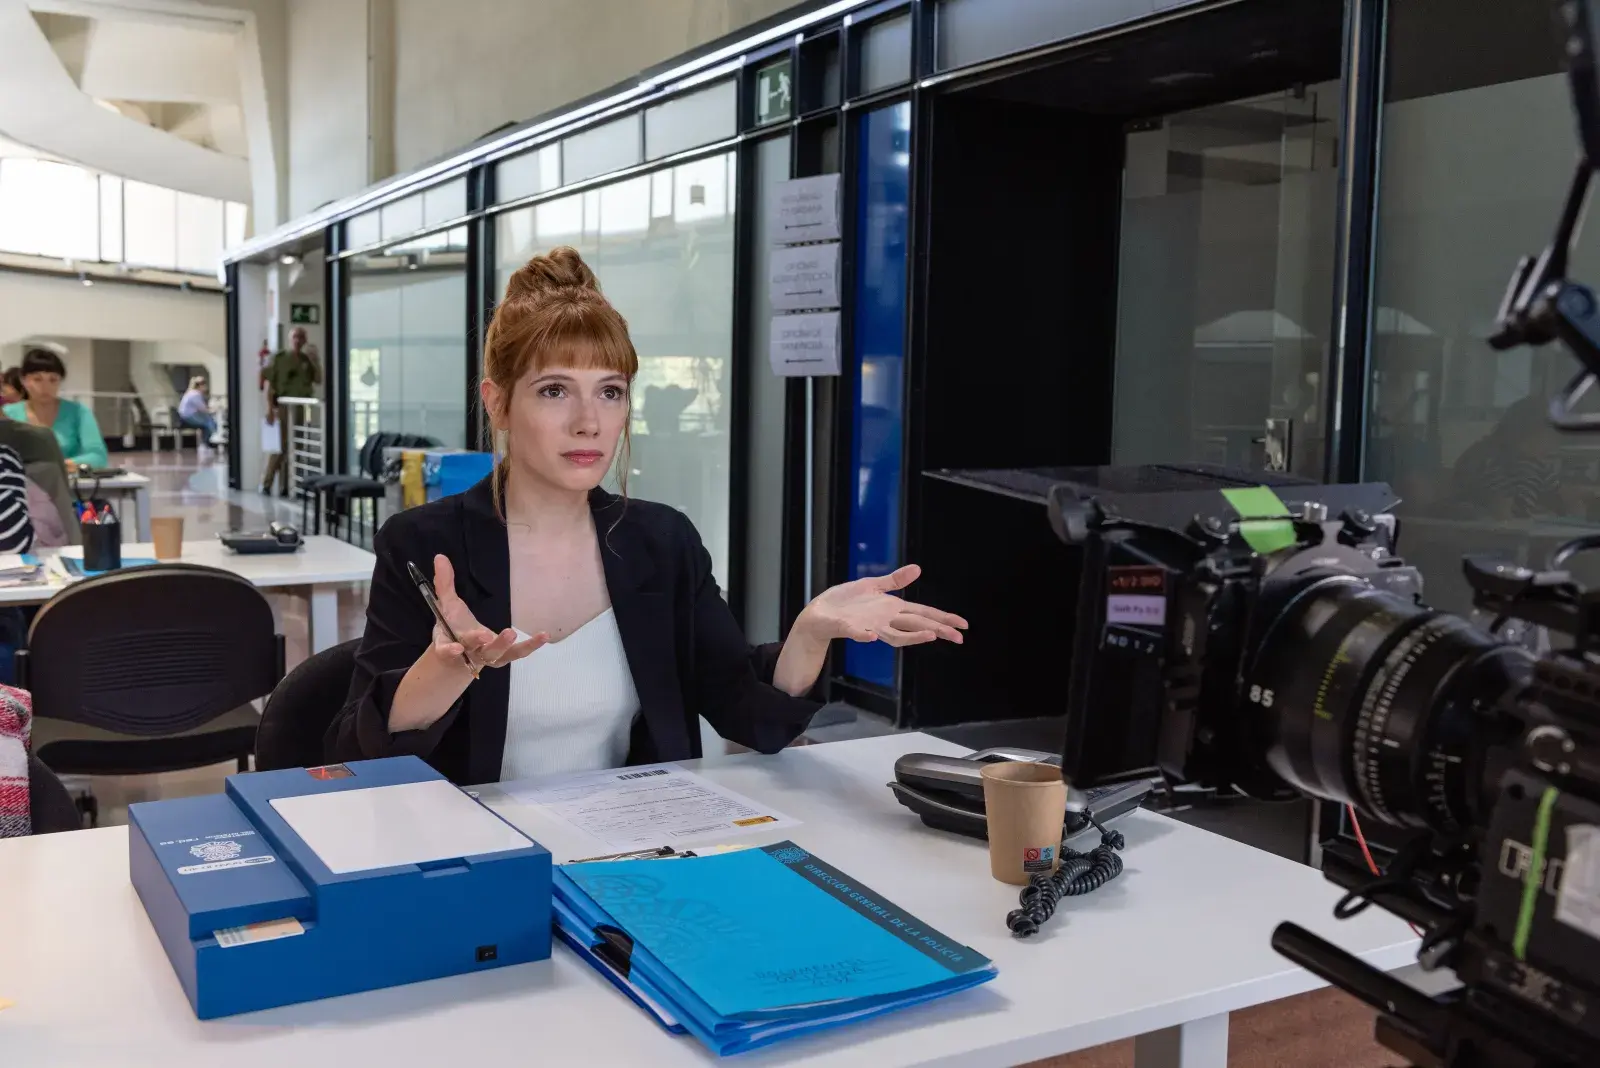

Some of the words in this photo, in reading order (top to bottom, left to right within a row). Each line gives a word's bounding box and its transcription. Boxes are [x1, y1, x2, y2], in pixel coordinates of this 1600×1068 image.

[1249, 684, 1275, 708] 85
[804, 863, 852, 894] DIRECCIÓN
[849, 891, 891, 919] GENERAL
[890, 917, 907, 929] DE
[905, 924, 921, 938] LA
[919, 935, 964, 962] POLICÍA
